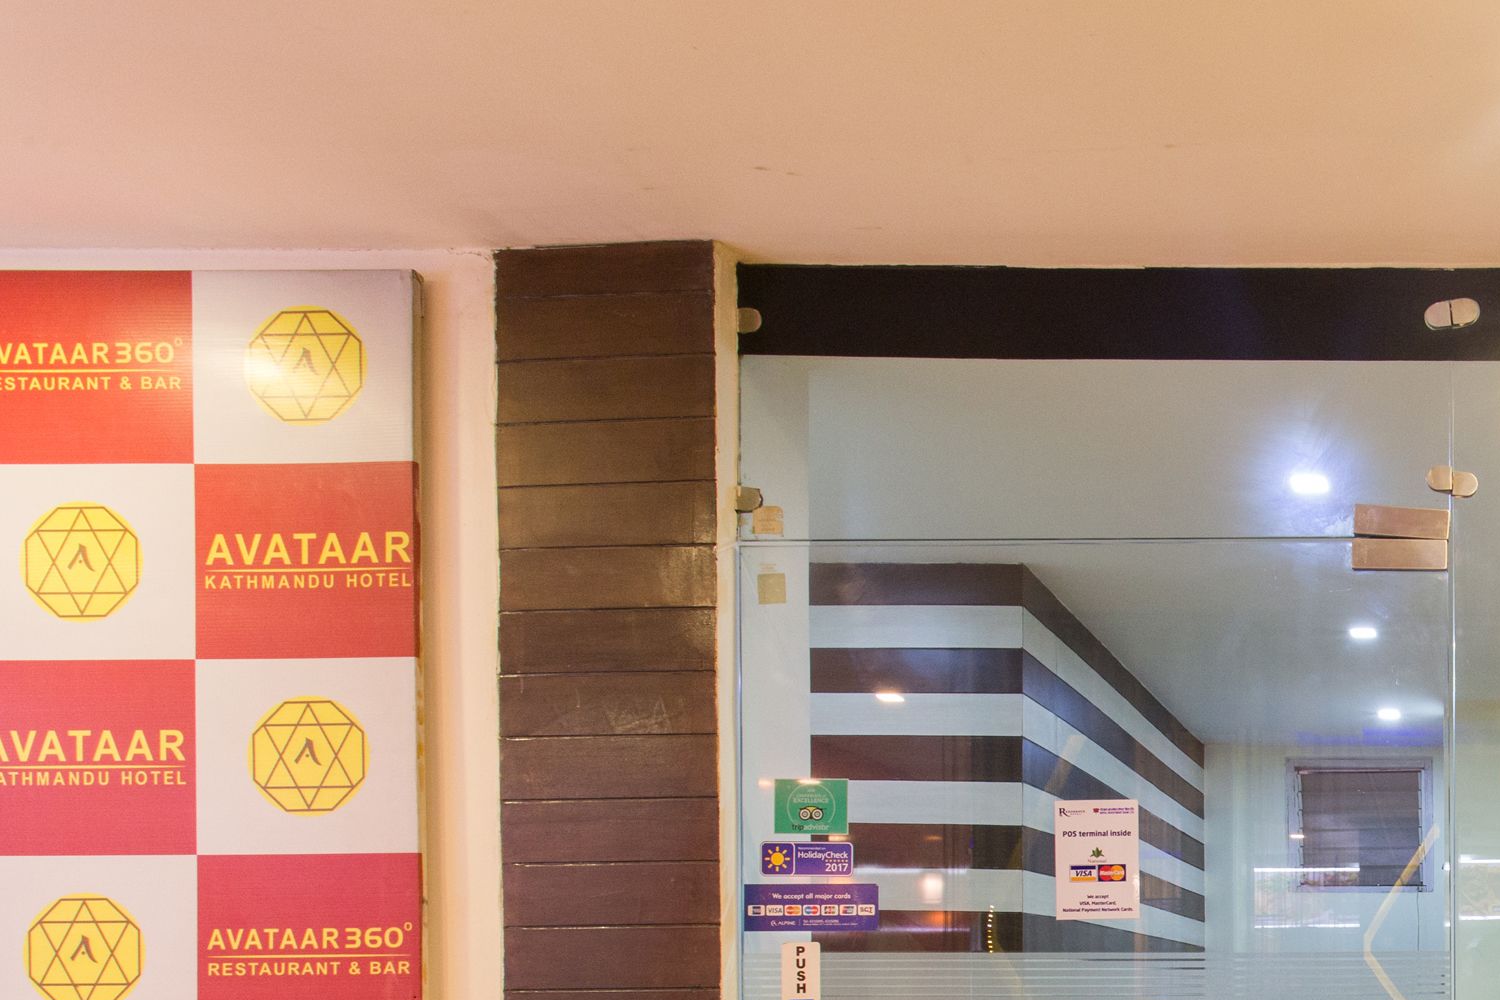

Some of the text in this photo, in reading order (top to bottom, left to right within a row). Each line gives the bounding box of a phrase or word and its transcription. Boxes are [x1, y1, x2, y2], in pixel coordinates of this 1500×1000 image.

[0, 376, 181, 391] STAURANT & BAR
[205, 531, 411, 566] AVATAAR
[205, 573, 411, 589] KATHMANDU HOTEL
[121, 770, 187, 785] HOTEL
[1110, 829, 1131, 837] inside
[798, 851, 848, 861] HolidayCheck
[825, 863, 848, 872] 2017
[208, 961, 410, 976] RESTAURANT & BAR
[796, 946, 806, 994] PUSH
